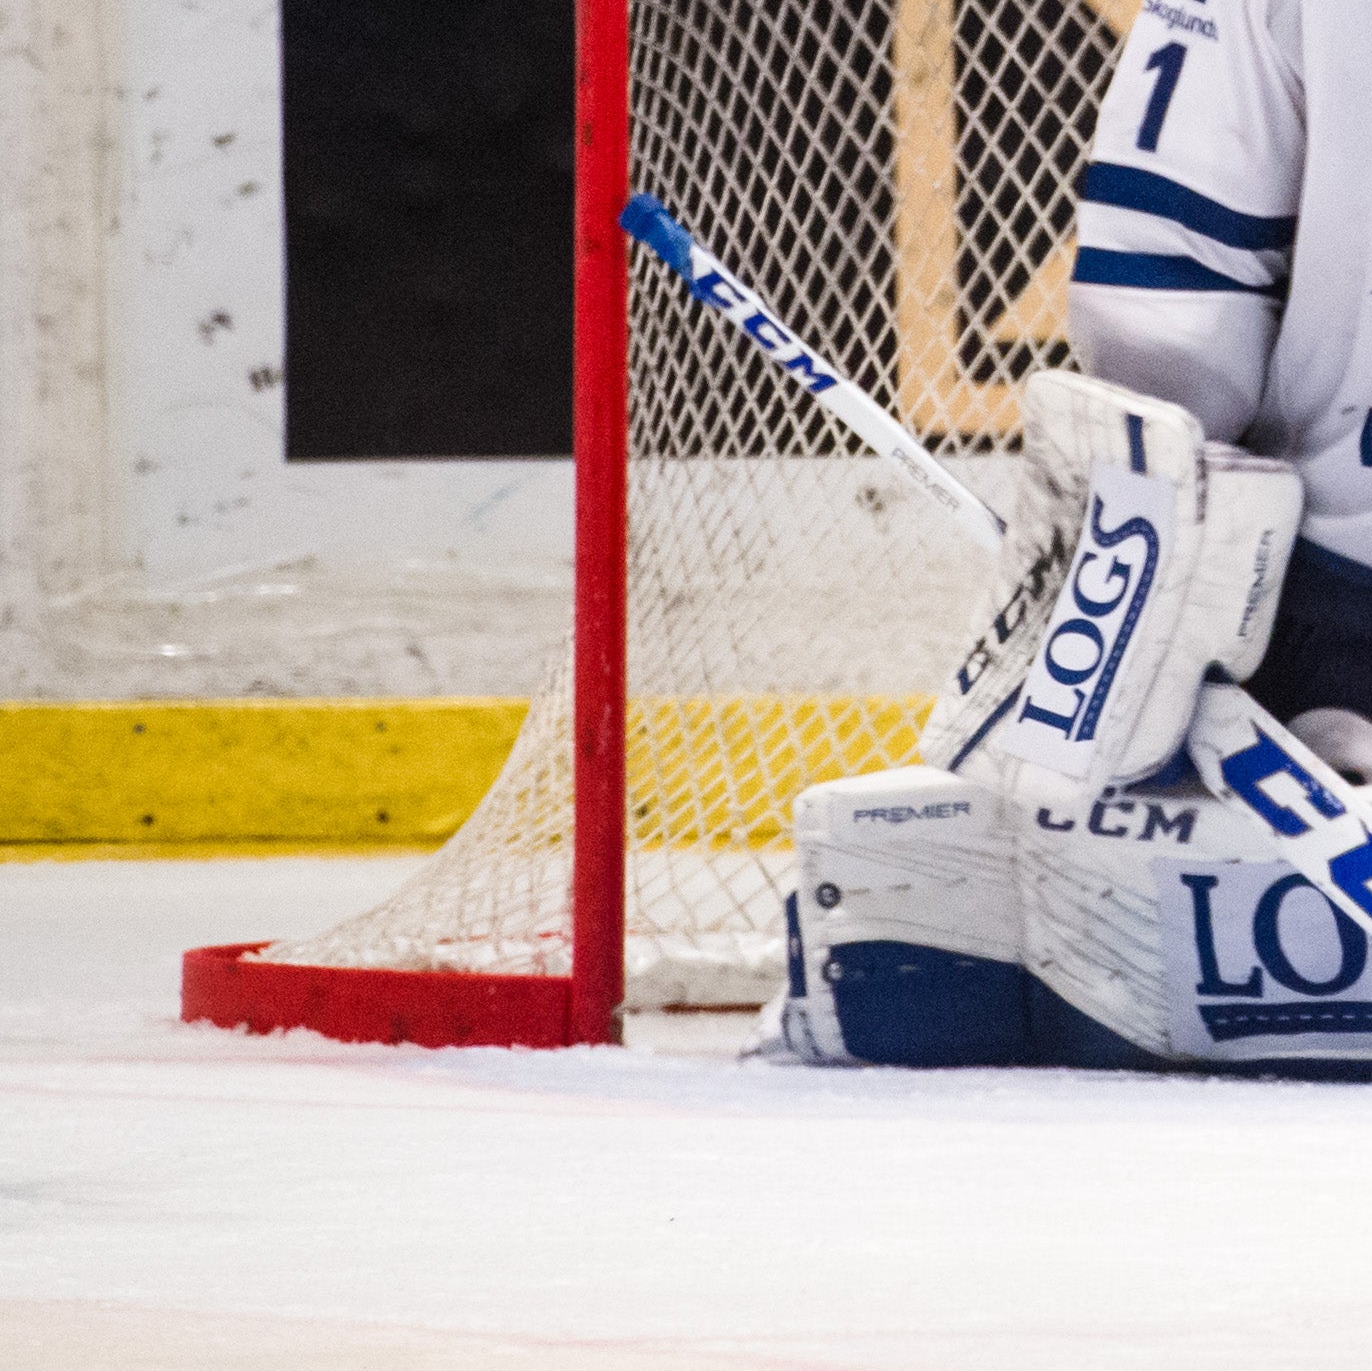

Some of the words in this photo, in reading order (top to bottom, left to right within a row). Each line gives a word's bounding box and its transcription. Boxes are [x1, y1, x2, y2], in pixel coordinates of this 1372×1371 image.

[1135, 41, 1189, 153] 1
[690, 268, 840, 394] CCM
[1017, 494, 1160, 742] LOGS
[853, 800, 971, 824] PREMIER
